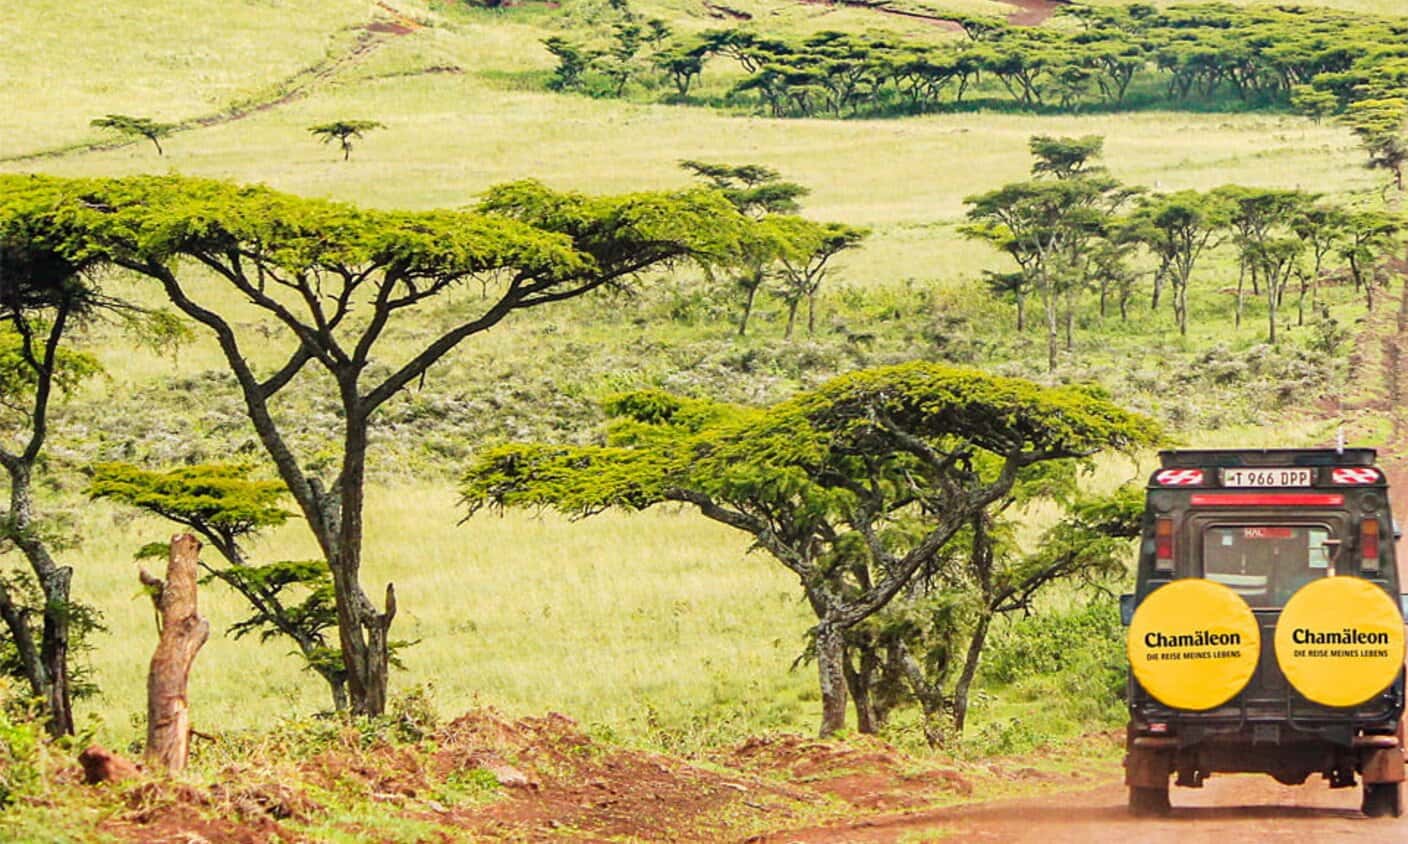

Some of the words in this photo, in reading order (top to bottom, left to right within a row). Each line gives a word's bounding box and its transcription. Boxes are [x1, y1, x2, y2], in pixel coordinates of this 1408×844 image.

[1235, 471, 1242, 486] T
[1247, 471, 1275, 486] 966
[1280, 471, 1308, 486] DPP
[1144, 630, 1241, 648] Chamäleon
[1292, 628, 1389, 645] Chamäleon
[1146, 651, 1159, 661] DIE
[1161, 651, 1181, 661] REISE
[1183, 650, 1212, 660] MEINES
[1213, 650, 1241, 659] LEBENS
[1294, 649, 1306, 658] DIE
[1308, 649, 1328, 658] REISE
[1330, 649, 1359, 658] MEINES
[1360, 649, 1389, 658] LEBENS
